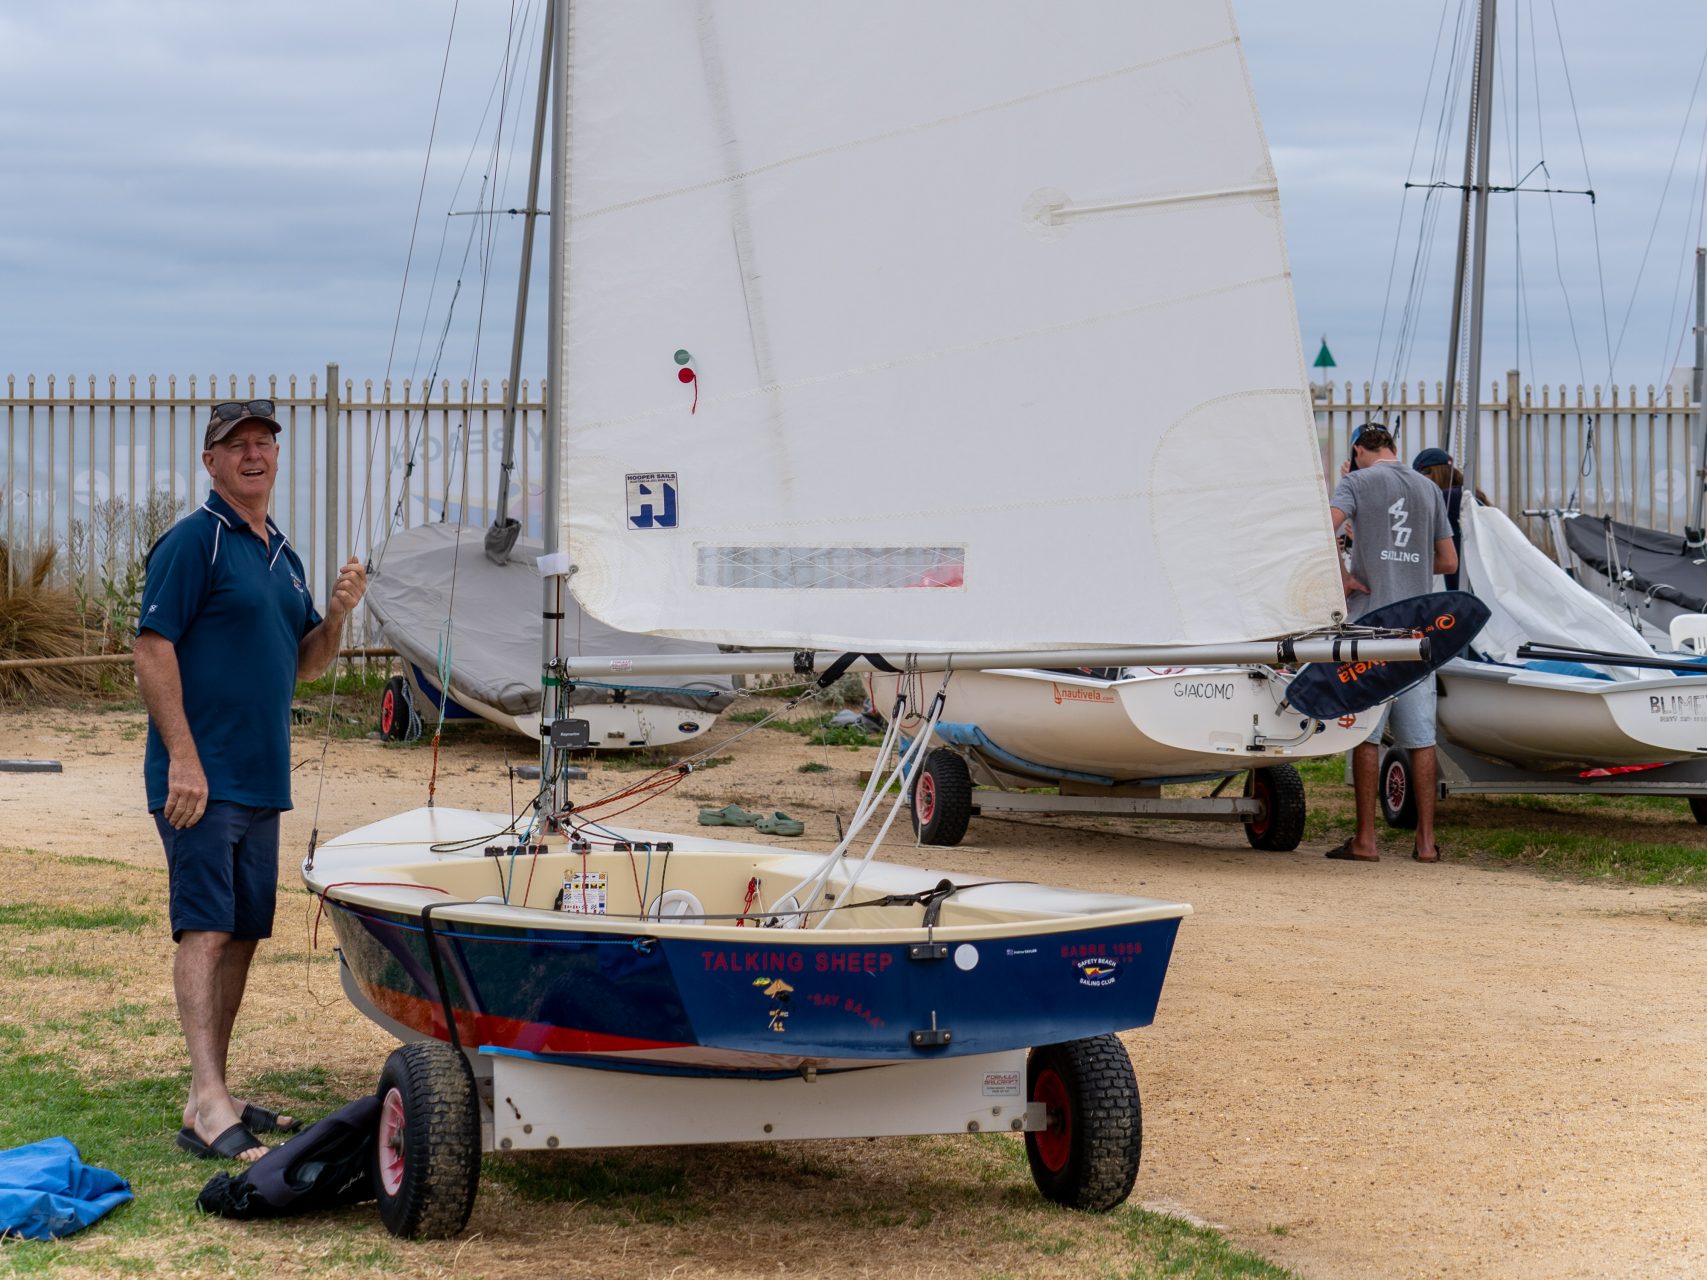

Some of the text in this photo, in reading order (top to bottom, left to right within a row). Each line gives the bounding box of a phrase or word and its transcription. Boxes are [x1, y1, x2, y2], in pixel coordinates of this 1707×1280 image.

[1388, 497, 1412, 548] 420
[1173, 682, 1235, 700] GIACOMO
[1649, 694, 1707, 716] BLIME
[702, 951, 893, 972] TALKING SHEEP
[1077, 957, 1098, 969] SAFETY
[1097, 957, 1117, 967] BEACH
[1079, 976, 1116, 987] SAILING CLUB
